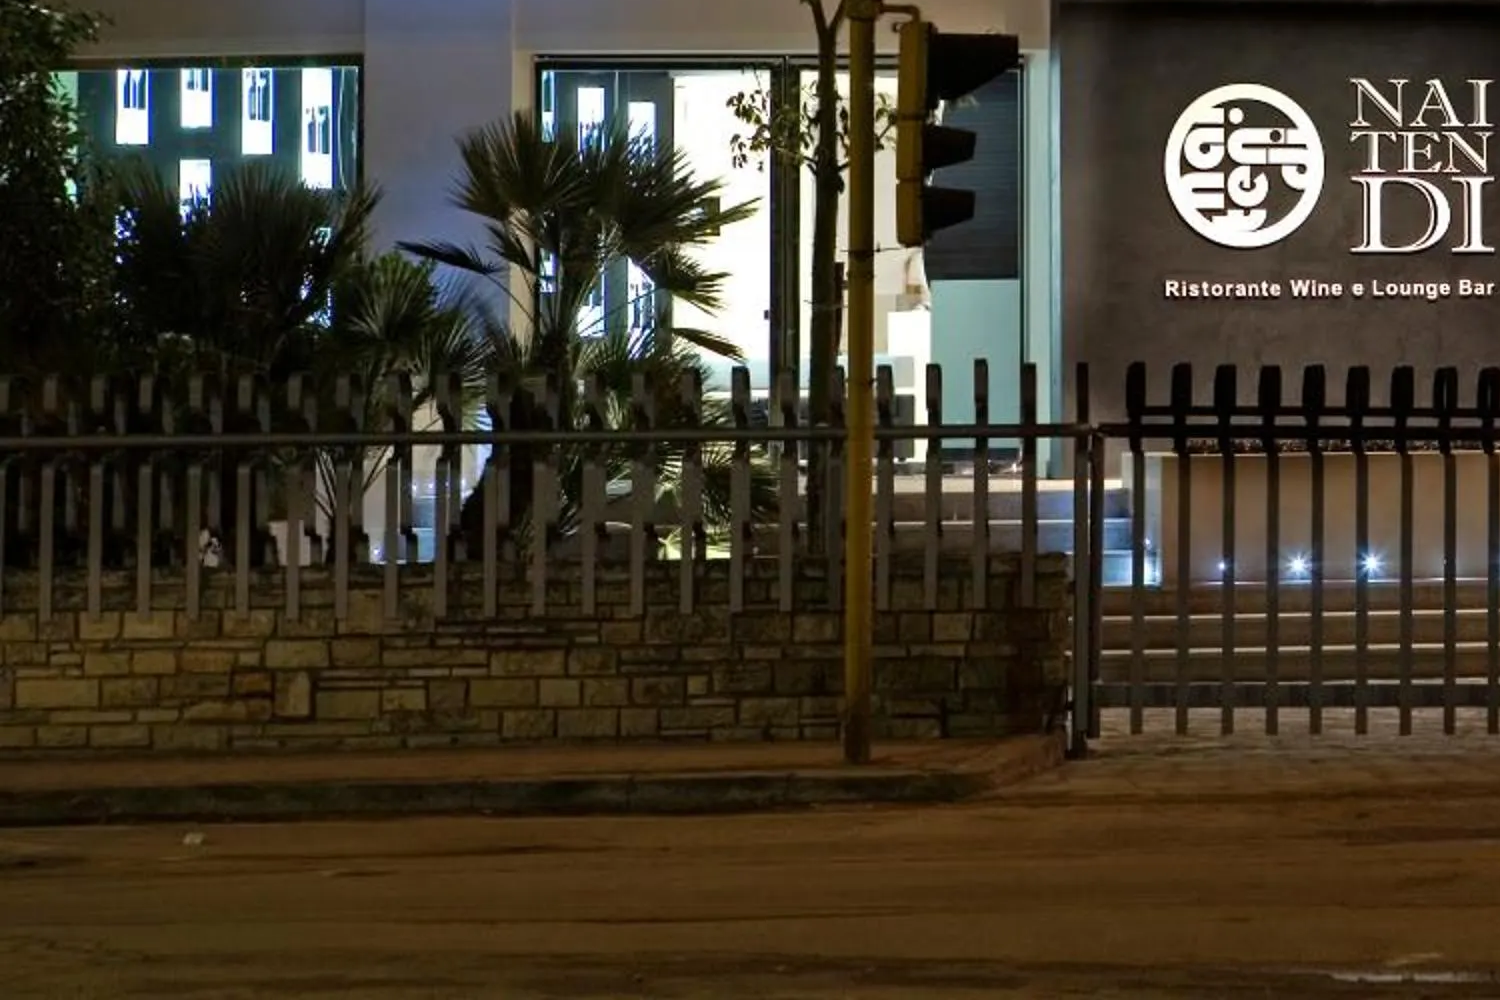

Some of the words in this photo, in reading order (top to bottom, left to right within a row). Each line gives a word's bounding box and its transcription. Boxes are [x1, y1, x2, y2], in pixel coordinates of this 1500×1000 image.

[1350, 77, 1495, 127] NAI
[1350, 130, 1494, 173] TEN
[1350, 175, 1495, 253] DI
[1165, 279, 1282, 297] Ristorante
[1289, 279, 1343, 297] Wine
[1351, 283, 1365, 297] e
[1371, 279, 1451, 300] Lounge
[1458, 279, 1496, 296] Bar
